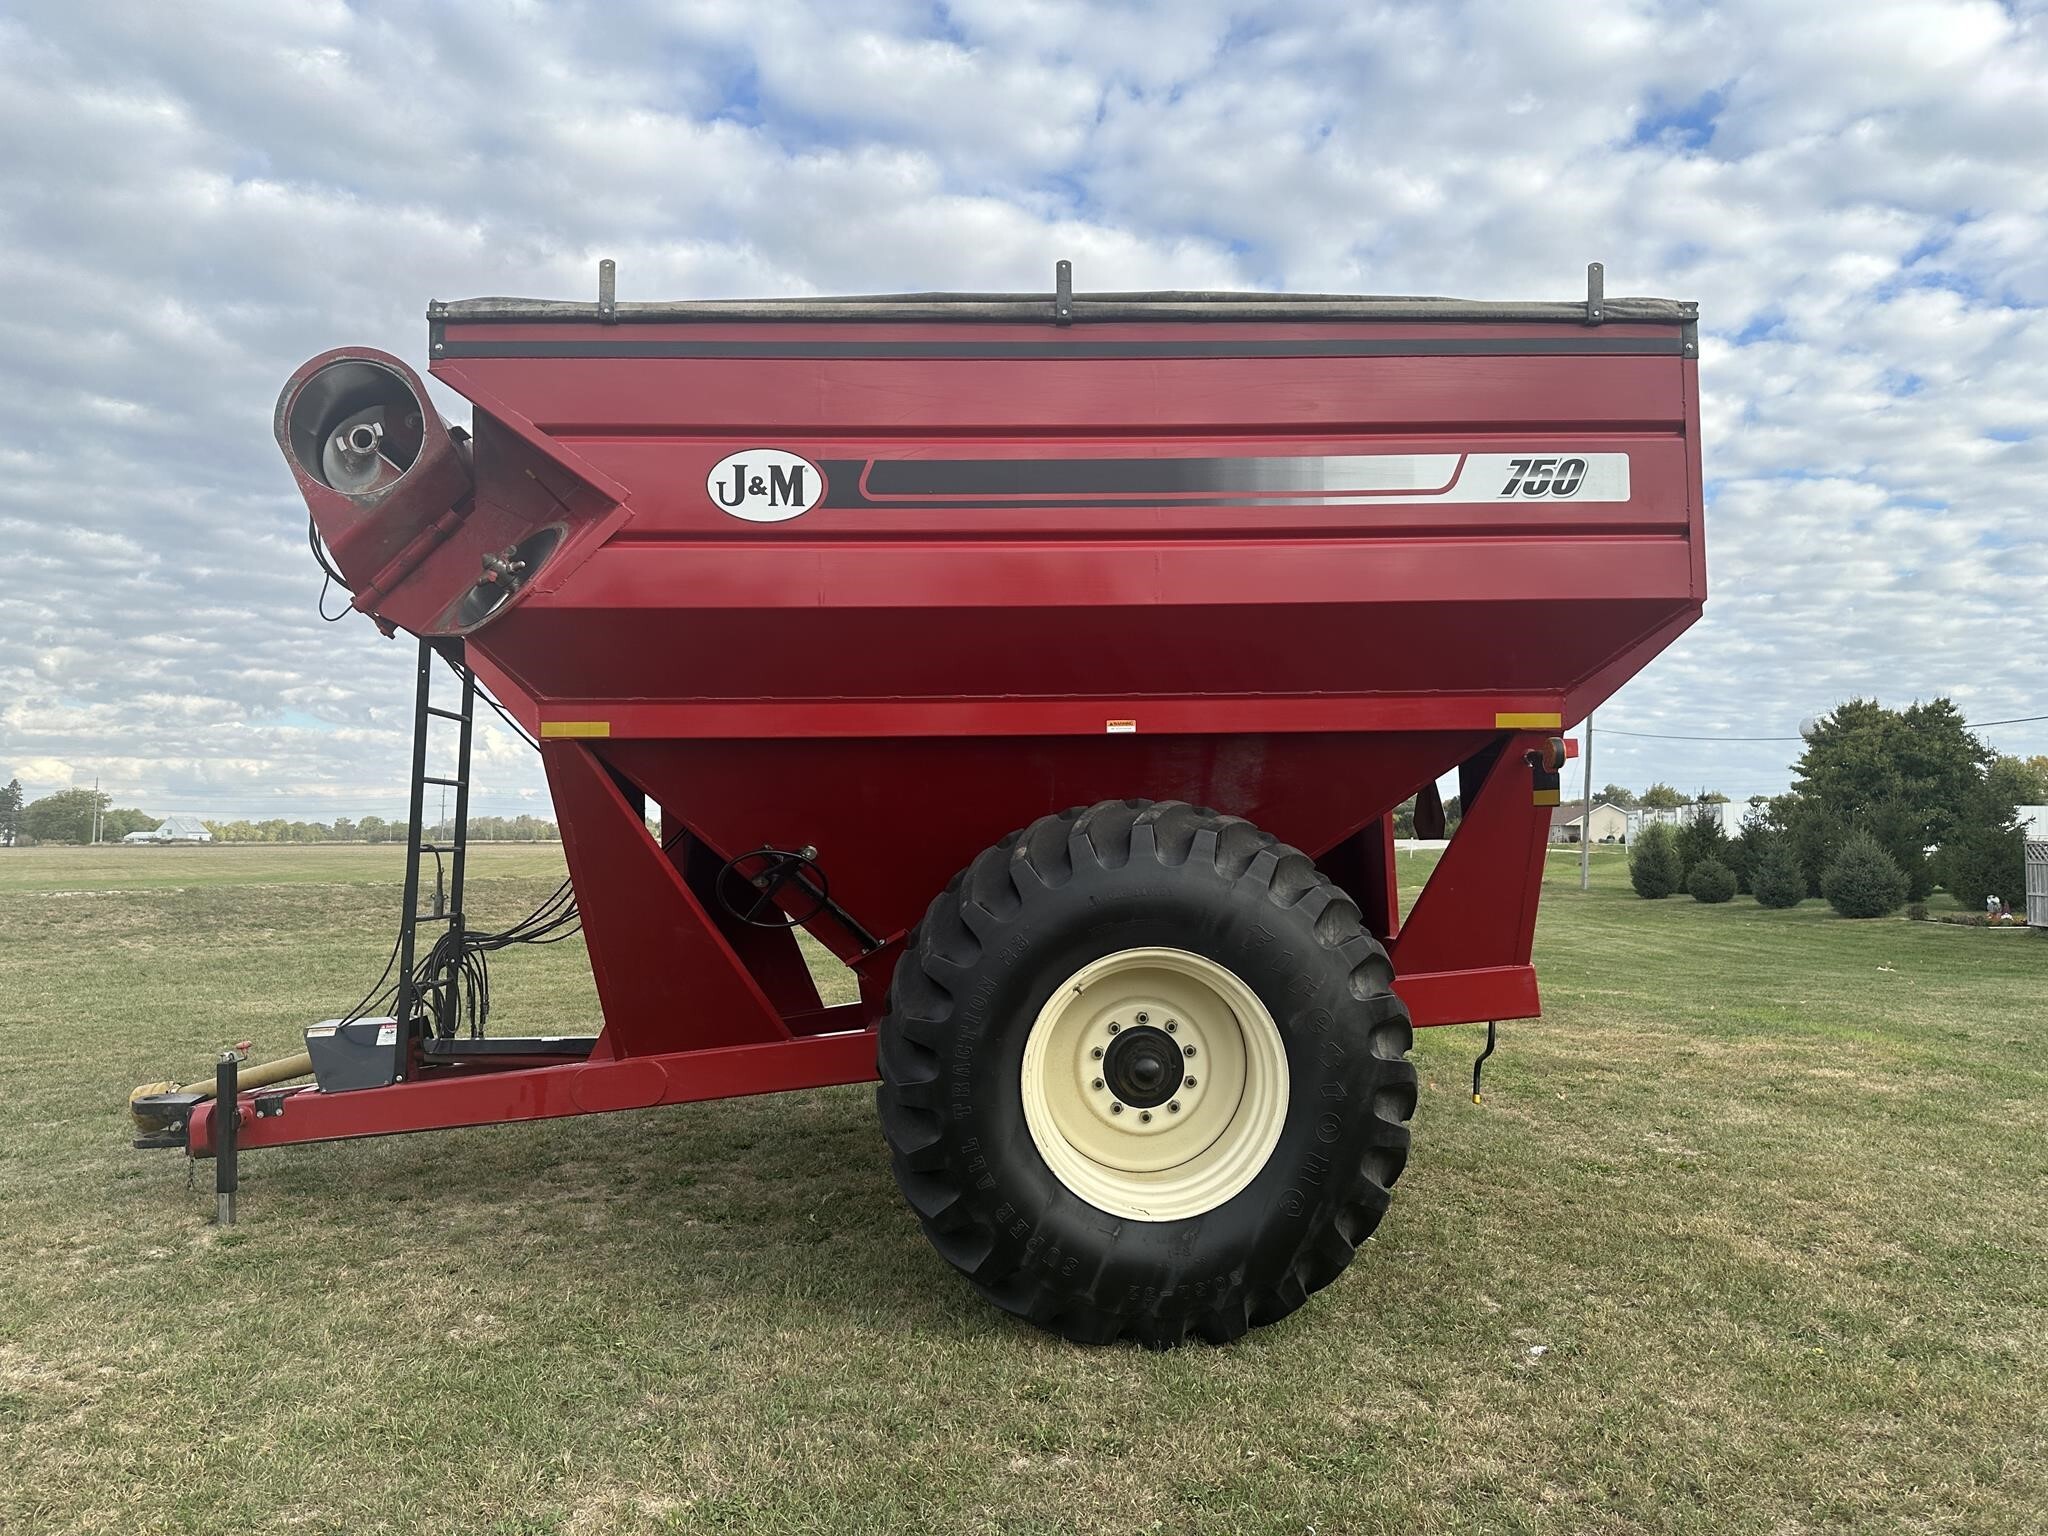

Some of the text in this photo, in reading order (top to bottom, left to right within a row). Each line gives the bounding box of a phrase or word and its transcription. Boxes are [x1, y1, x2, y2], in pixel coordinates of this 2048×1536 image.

[716, 464, 806, 507] J&M
[1499, 458, 1588, 498] 750
[952, 975, 999, 1120] TRACTION
[961, 1137, 997, 1192] ALL
[995, 1202, 1081, 1278] SUPER
